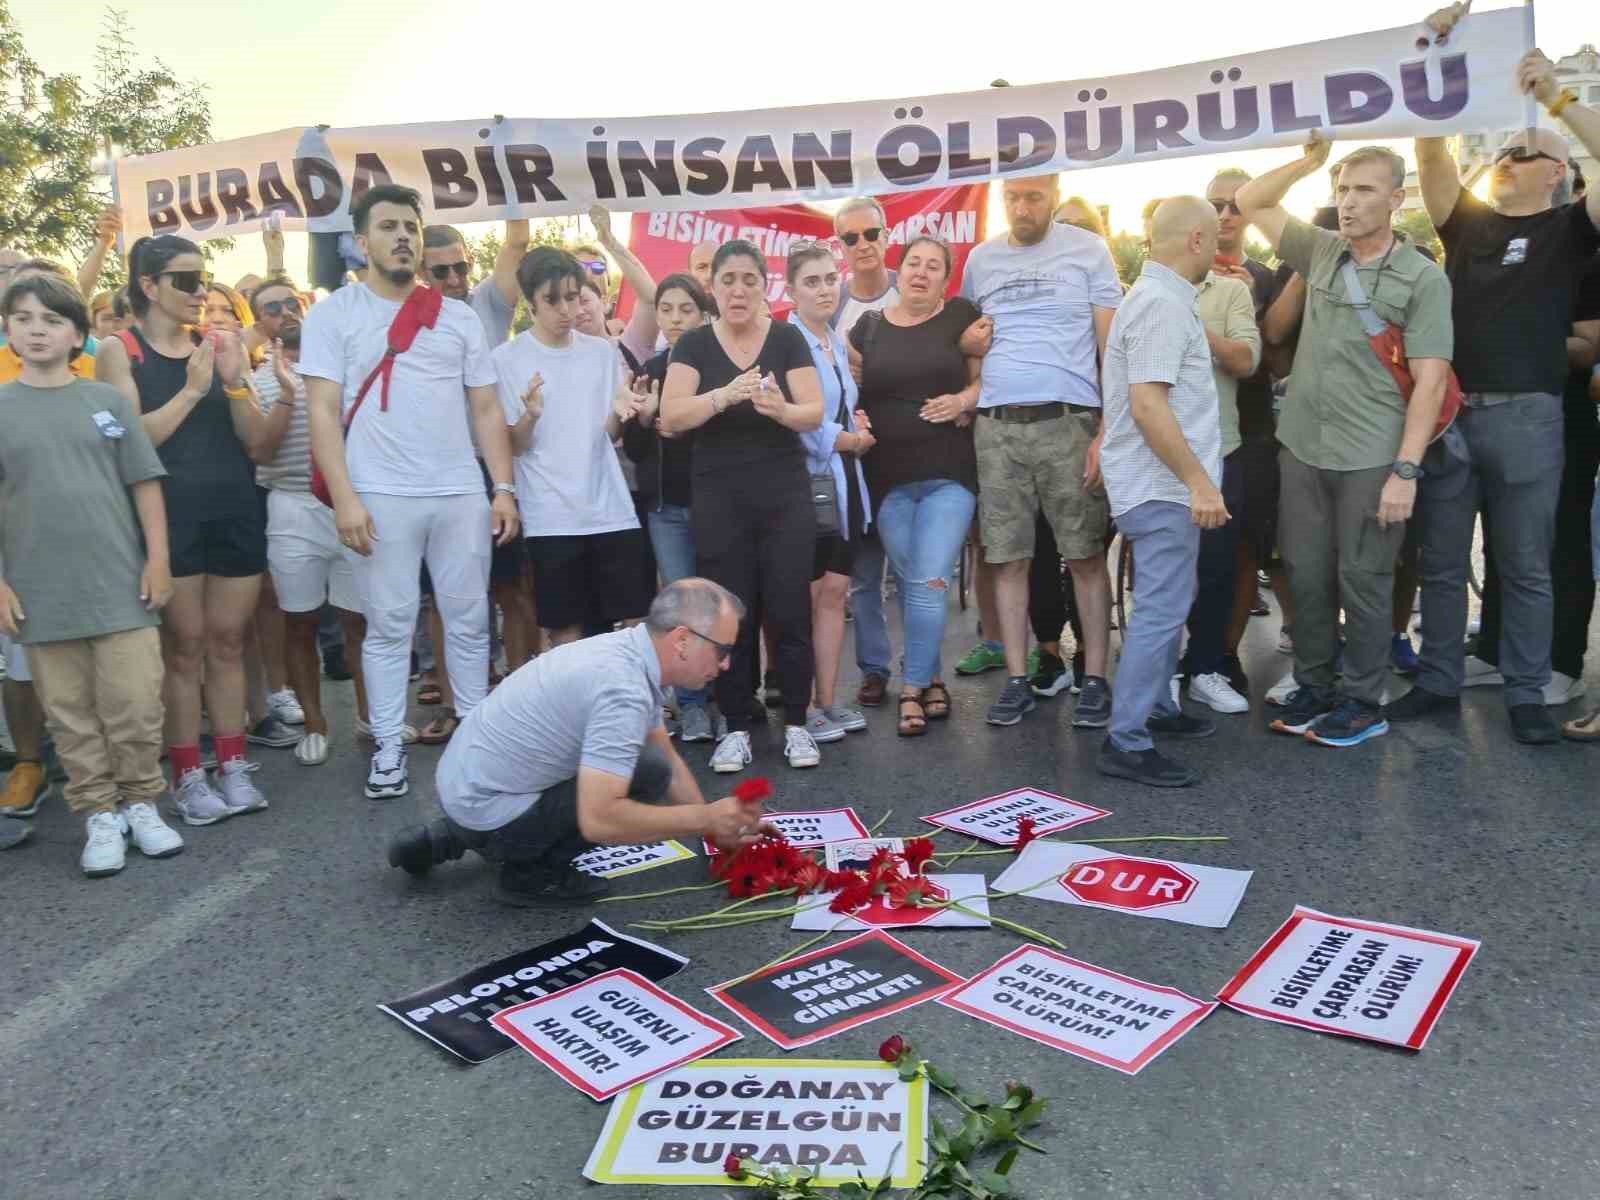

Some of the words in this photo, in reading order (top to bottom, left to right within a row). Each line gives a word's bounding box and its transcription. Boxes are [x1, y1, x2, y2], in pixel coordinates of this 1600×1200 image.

[146, 153, 394, 235] BURADA
[422, 127, 568, 210] BİR
[585, 126, 853, 199] İNSAN
[875, 33, 1470, 187] ÖLDÜRÜLDÜ
[1071, 865, 1185, 899] DUR
[406, 940, 616, 1023] PELOTONDA
[771, 958, 855, 990] KAZA
[792, 969, 883, 1002] DEĞİL
[1016, 964, 1176, 1020] BİSİKLETİME
[1270, 929, 1354, 1008] BİSİKLETİME
[1312, 939, 1389, 1019] ÇARPARSAN
[1353, 955, 1424, 1020] ÖLÜRÜM!
[598, 990, 696, 1045] GÜVENLİ
[793, 973, 922, 1024] CİNAYET!
[993, 991, 1116, 1039] ÖLÜRÜM!
[997, 976, 1149, 1031] ÇARPARSAN
[533, 1017, 619, 1074] HAKTIR!
[570, 1005, 650, 1058] ULAŞIM
[659, 1074, 896, 1100] DOĞANAY
[636, 1104, 901, 1132] GÜZELGÜN
[657, 1141, 866, 1166] BURADA
